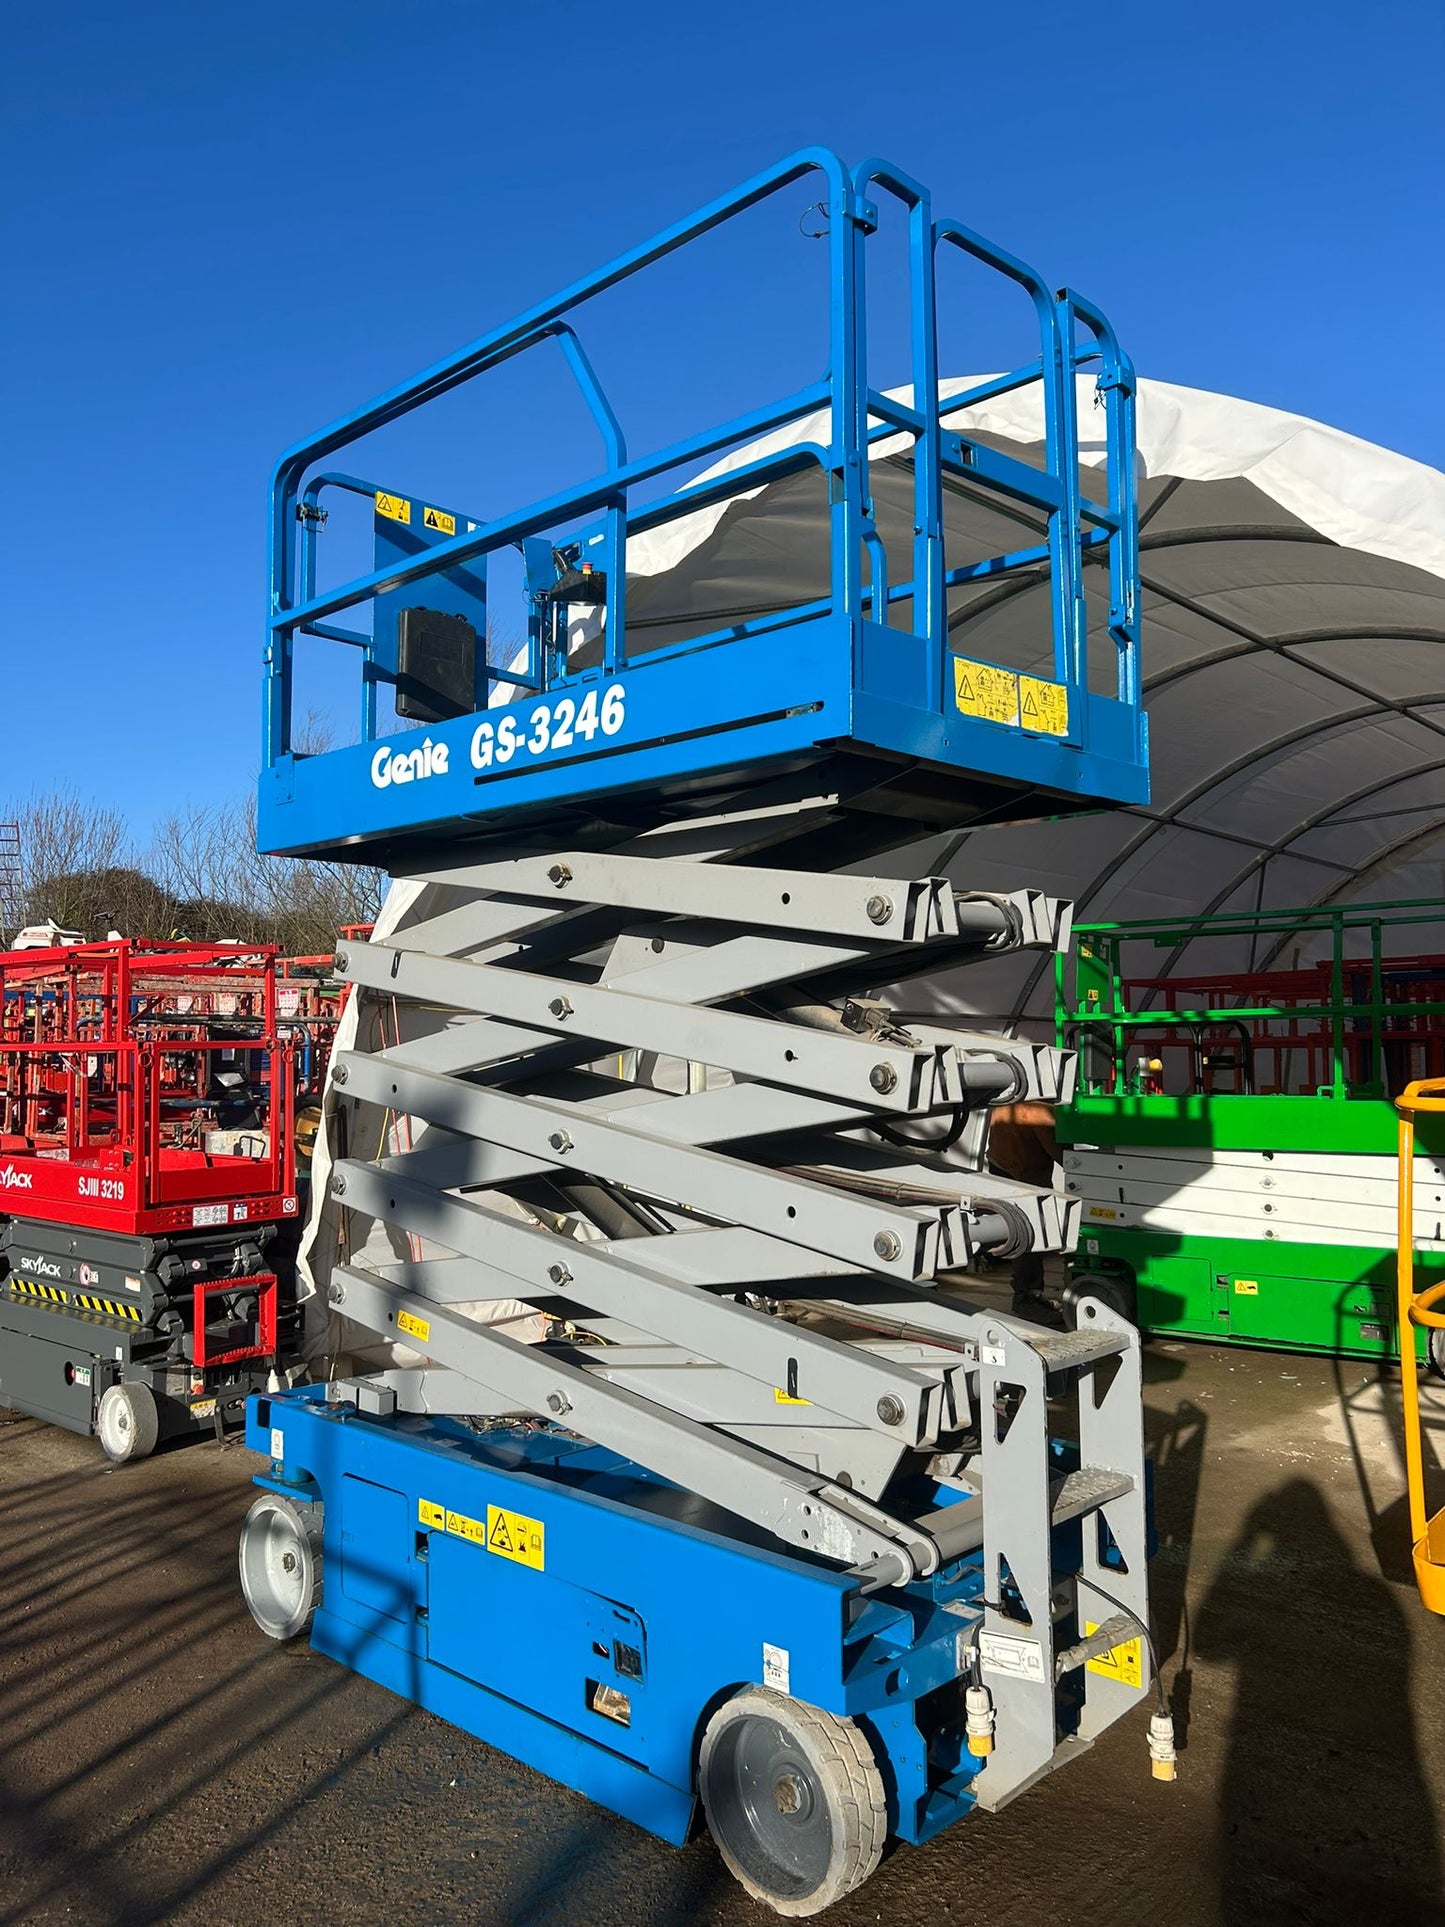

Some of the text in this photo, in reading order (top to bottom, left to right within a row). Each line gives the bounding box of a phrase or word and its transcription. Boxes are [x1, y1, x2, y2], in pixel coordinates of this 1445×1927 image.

[371, 683, 626, 789] Genie GS-3246
[0, 1164, 33, 1189] YJACK
[78, 1176, 125, 1201] SJIII 3219
[20, 1255, 62, 1278] SKYJACK
